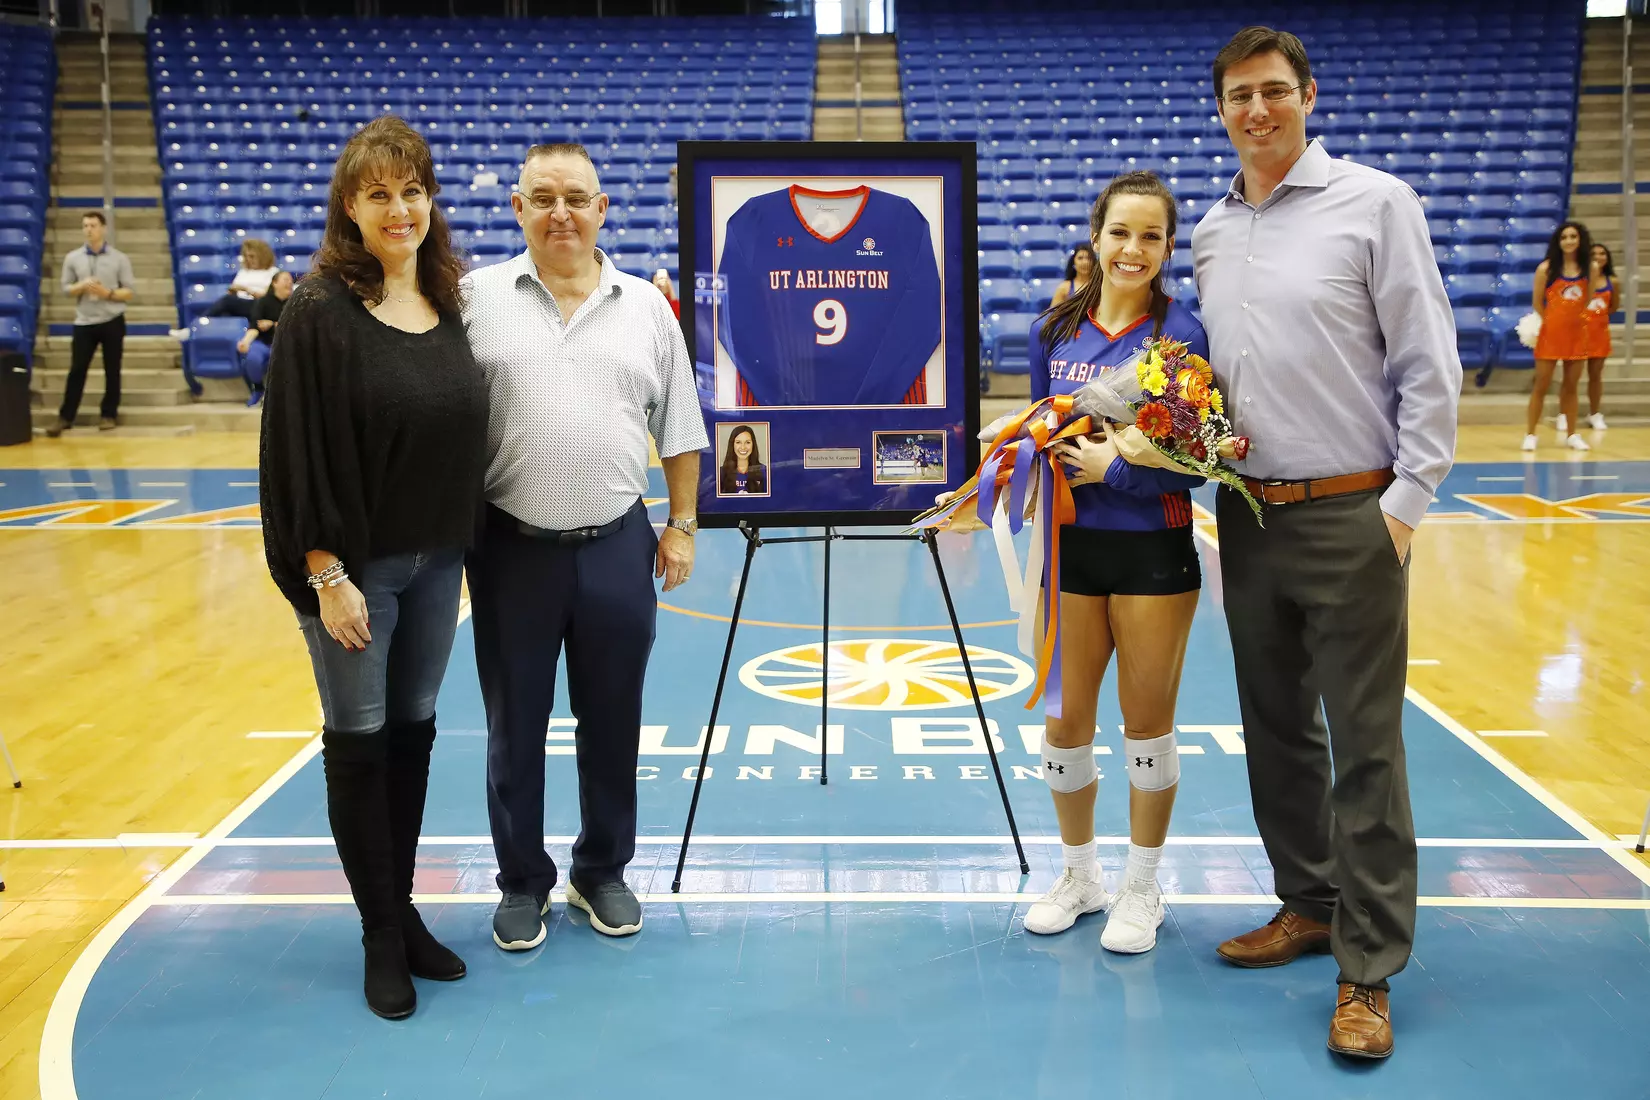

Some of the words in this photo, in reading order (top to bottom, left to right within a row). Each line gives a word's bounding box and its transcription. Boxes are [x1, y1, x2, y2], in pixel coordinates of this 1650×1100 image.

[769, 270, 791, 290] UT
[795, 270, 889, 290] ARLINGTON
[812, 298, 848, 346] 9
[1050, 360, 1068, 380] UT
